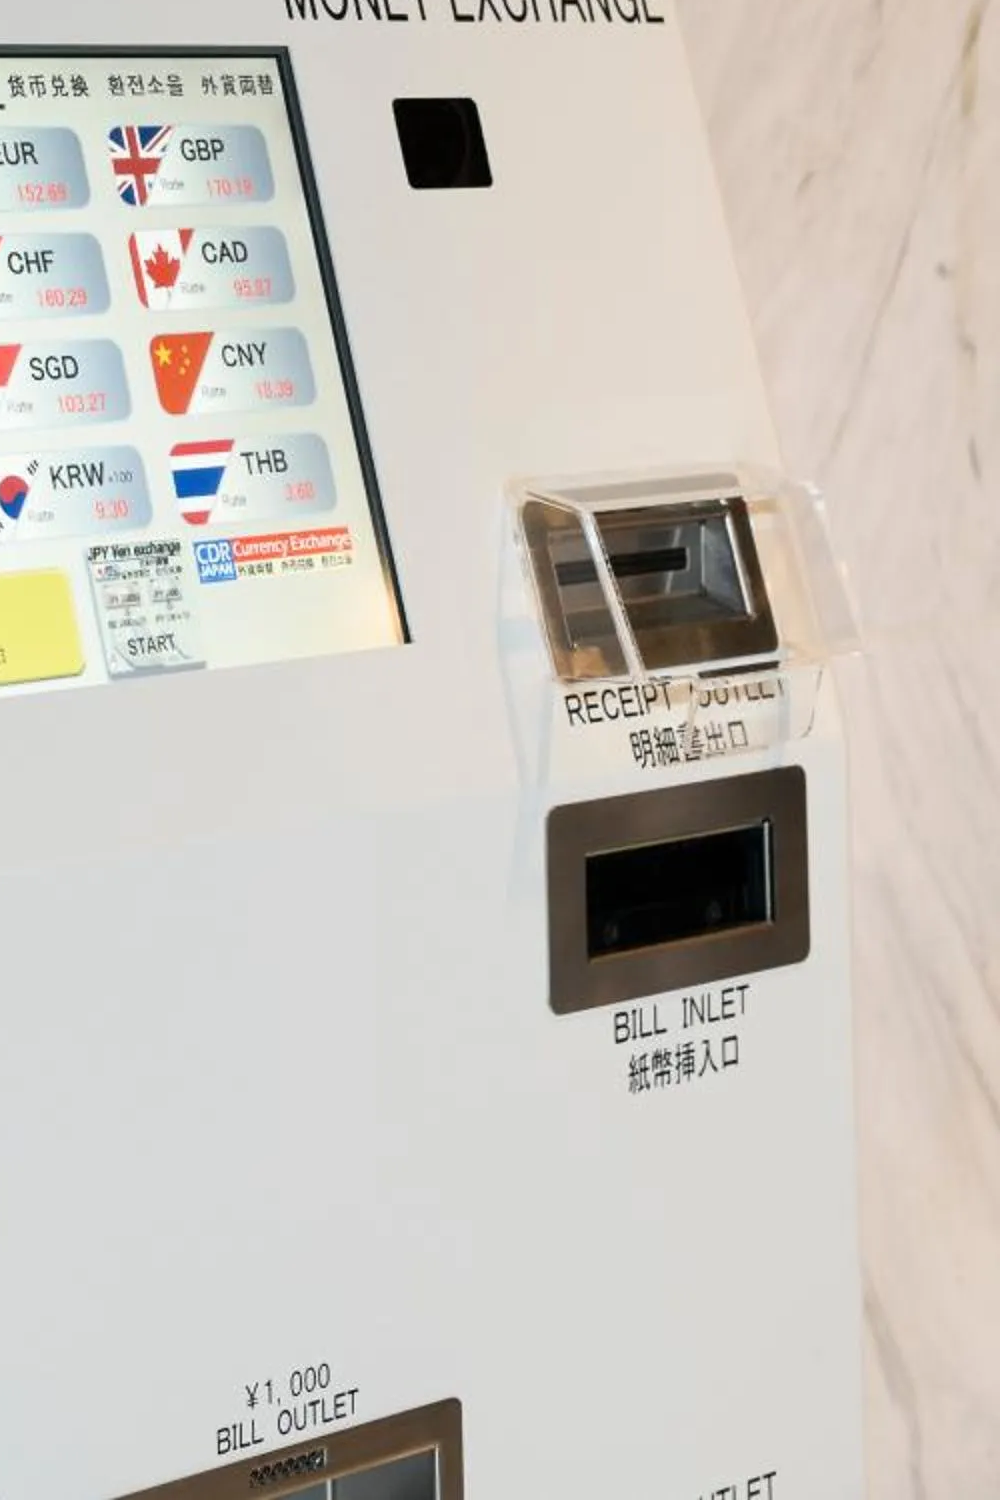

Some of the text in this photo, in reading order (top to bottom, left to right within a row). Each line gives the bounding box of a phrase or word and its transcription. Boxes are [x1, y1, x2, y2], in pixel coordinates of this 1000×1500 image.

[201, 75, 274, 95] 外貨両替
[181, 138, 225, 162] GBP
[7, 250, 55, 275] CHF
[202, 241, 249, 264] CAD
[221, 343, 267, 367] CNY
[30, 355, 79, 381] SGD
[240, 449, 289, 476] THB
[50, 461, 105, 490] KRW
[196, 542, 231, 564] CDR
[233, 540, 289, 557] Currency
[201, 563, 233, 577] JAPAN
[128, 634, 175, 656] START
[564, 681, 672, 726] RECEIPT
[613, 985, 750, 1044] BILL INLET
[217, 1388, 359, 1455] BILL OUTLET
